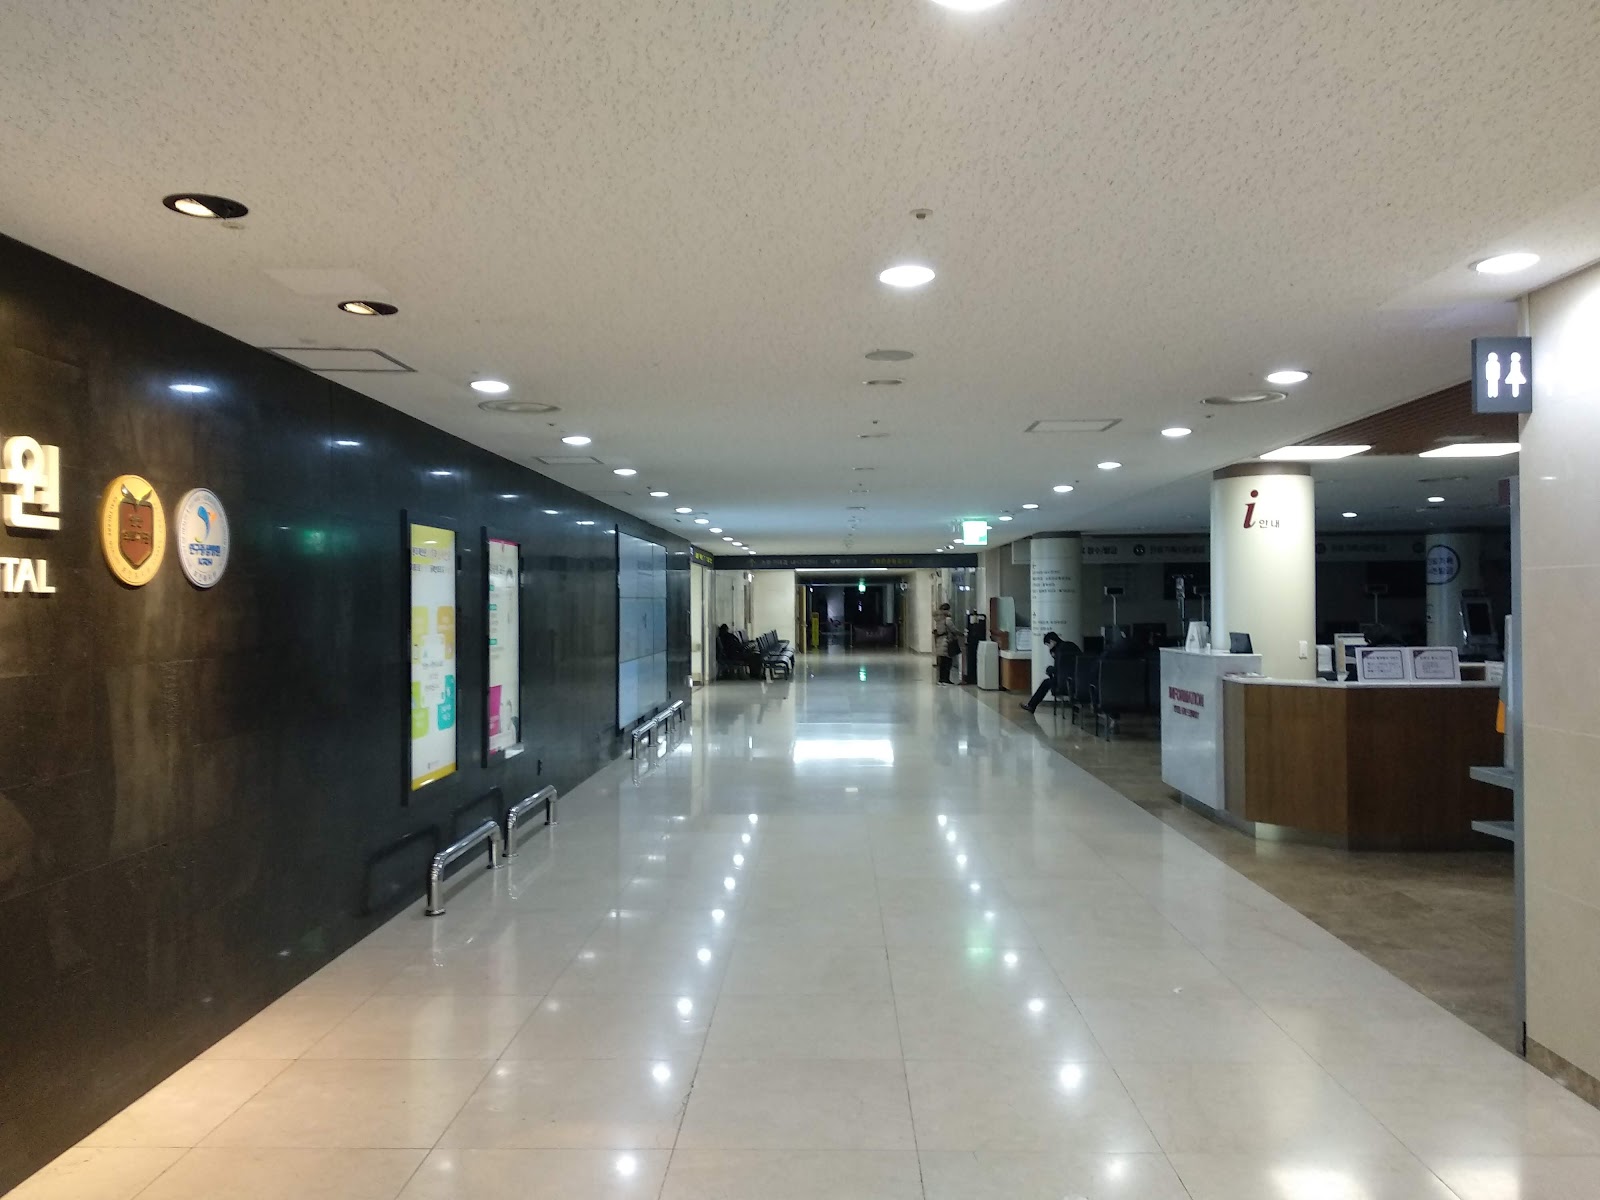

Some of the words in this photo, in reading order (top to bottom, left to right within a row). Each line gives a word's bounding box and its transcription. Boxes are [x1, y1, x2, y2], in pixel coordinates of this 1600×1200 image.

[0, 435, 60, 531] 원
[1259, 520, 1280, 529] 안내
[0, 556, 56, 594] TAL
